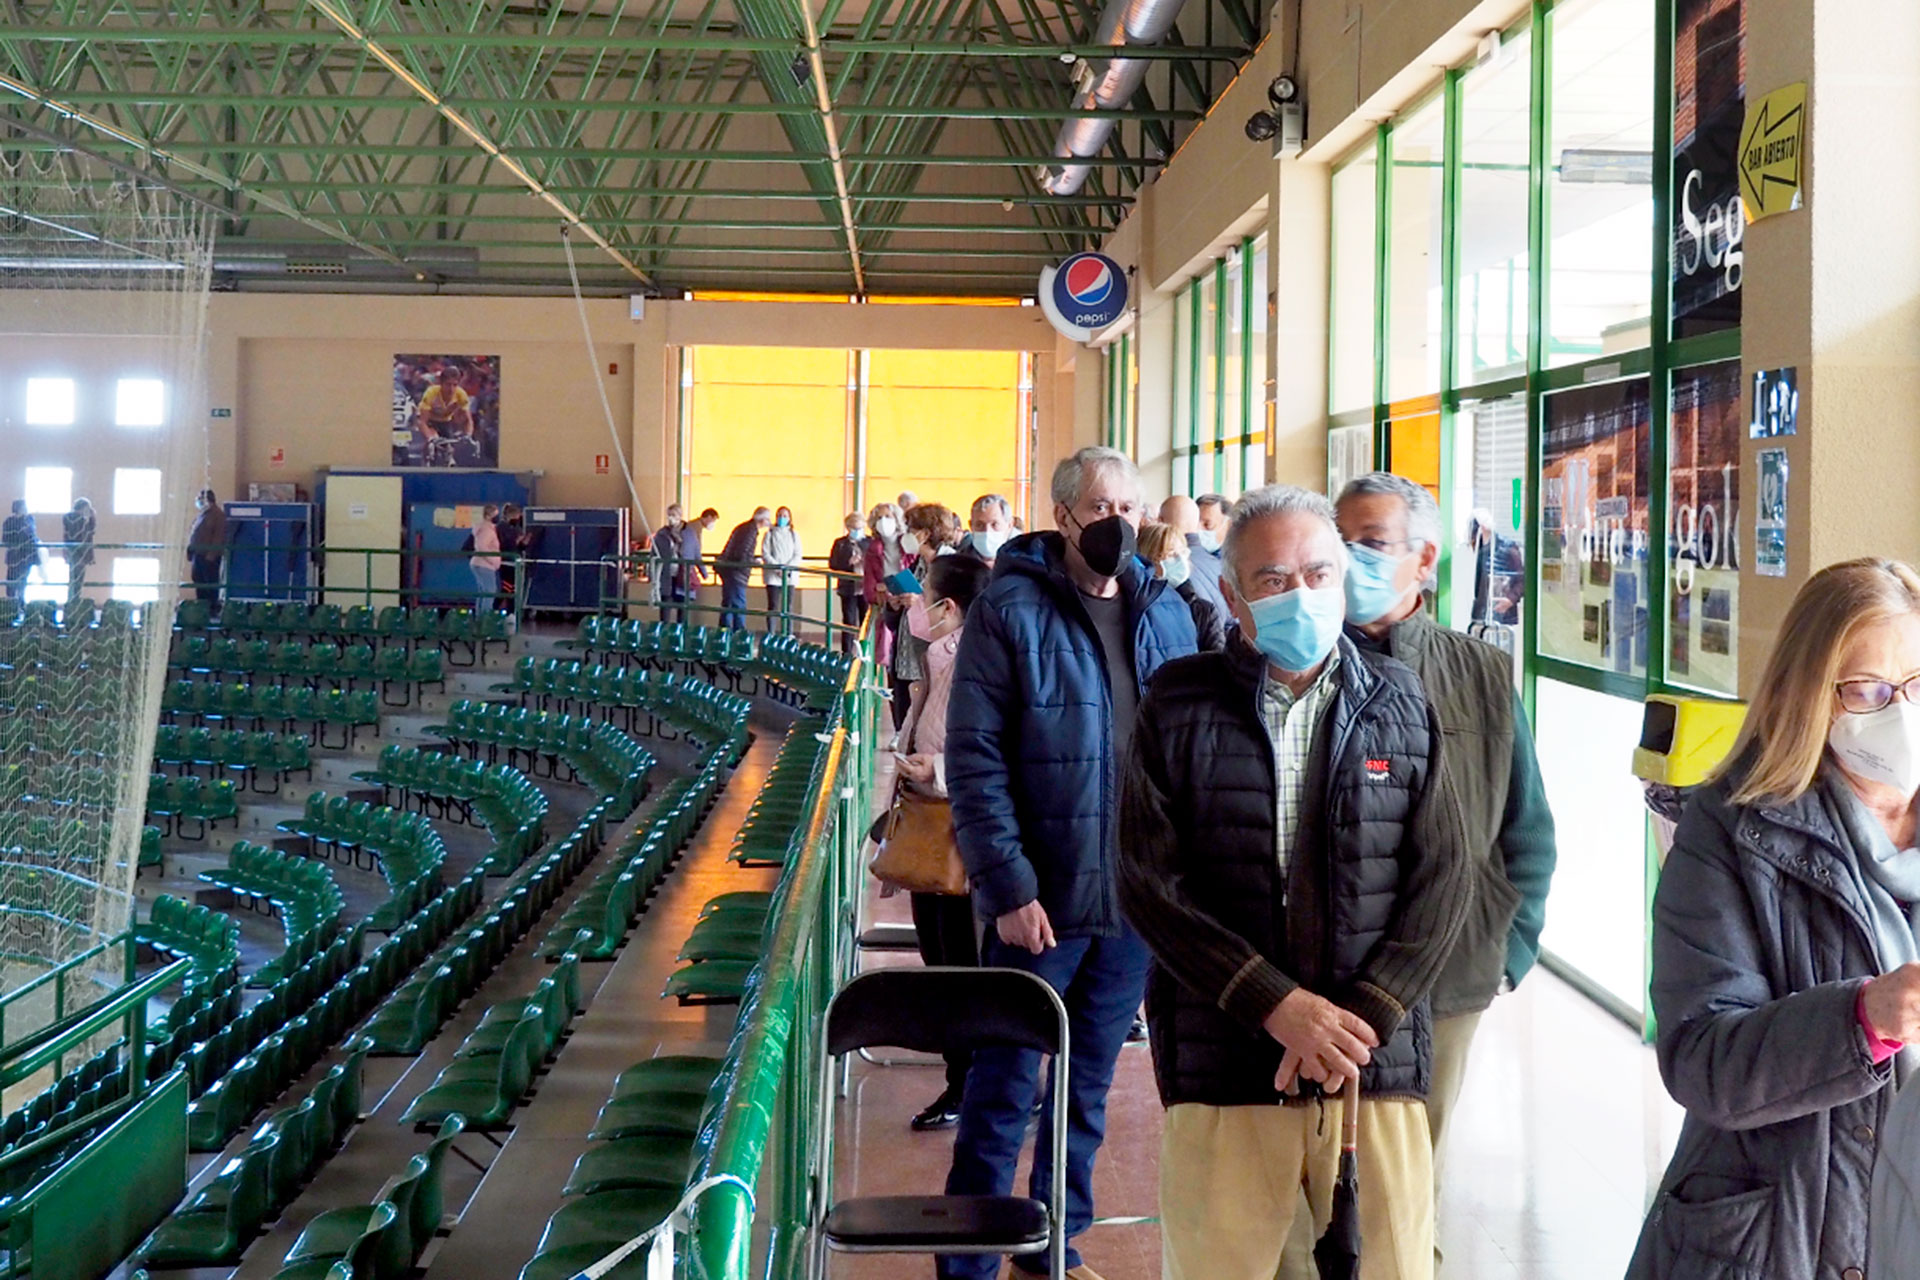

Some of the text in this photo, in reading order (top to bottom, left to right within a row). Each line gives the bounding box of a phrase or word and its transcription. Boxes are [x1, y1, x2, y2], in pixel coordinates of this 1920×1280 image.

[1749, 135, 1795, 171] BAR ABIERTO
[1076, 313, 1107, 325] pepsi
[1676, 461, 1739, 595] gol
